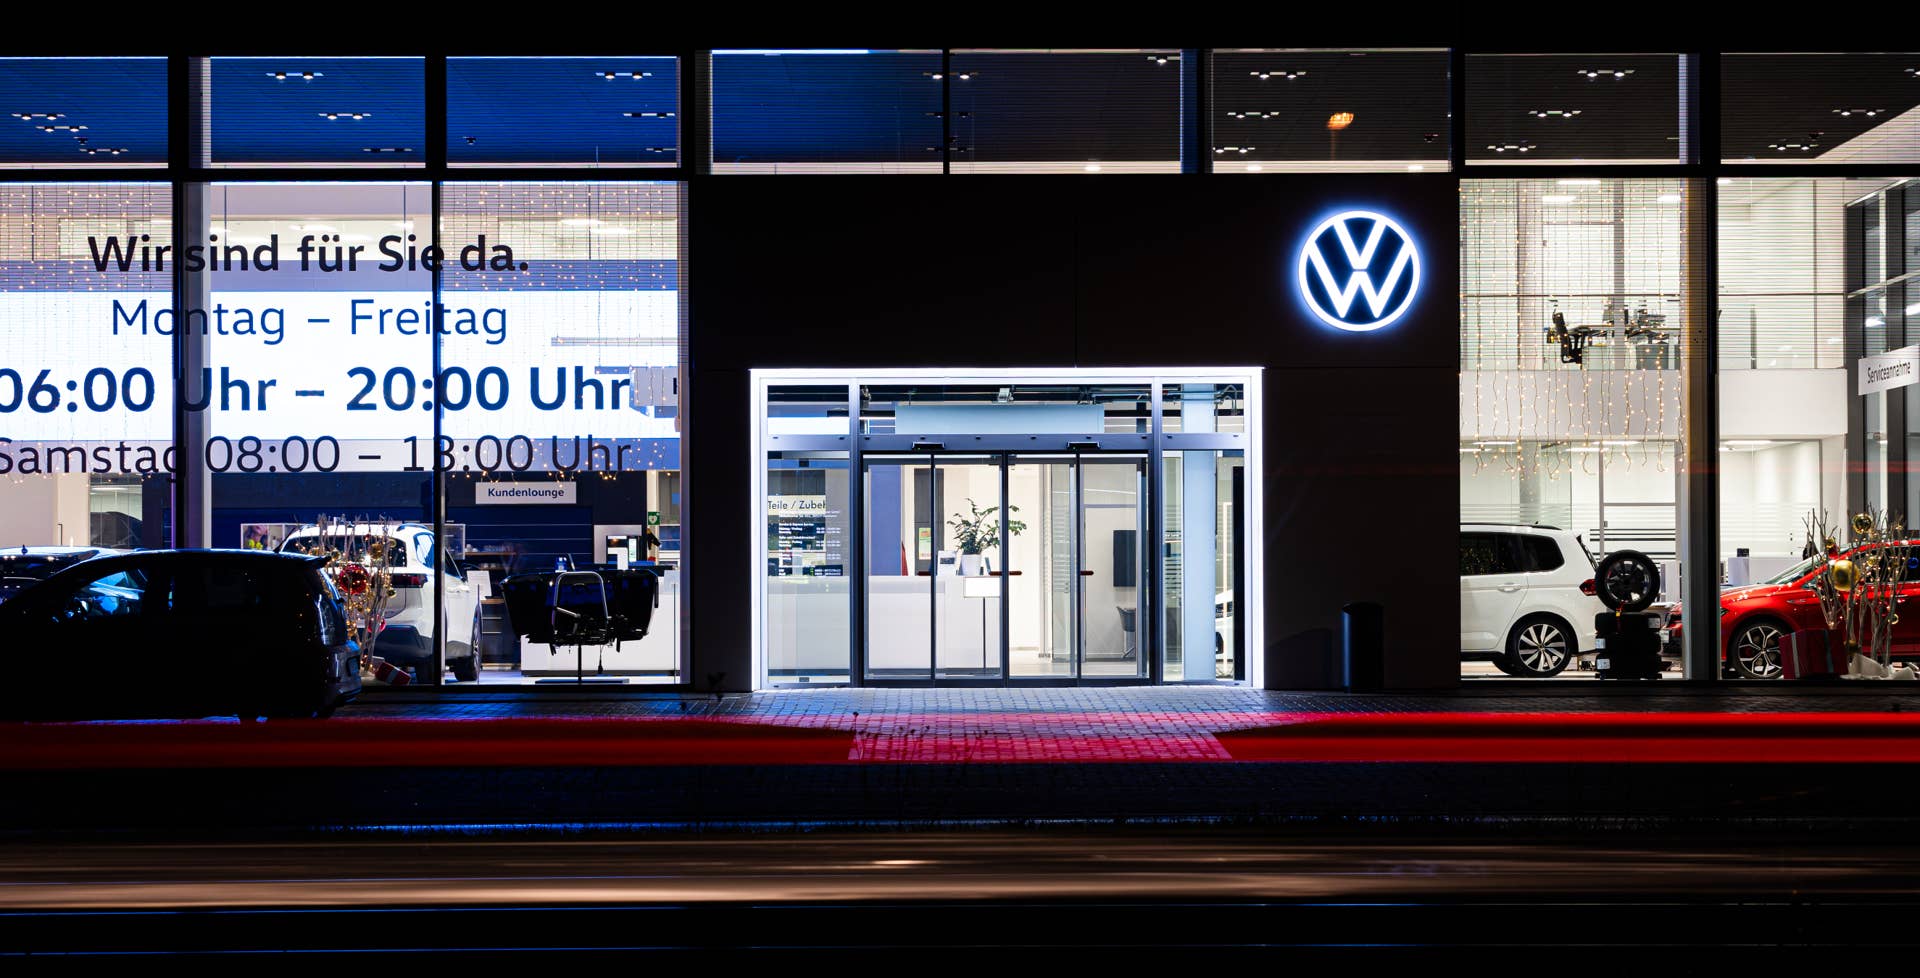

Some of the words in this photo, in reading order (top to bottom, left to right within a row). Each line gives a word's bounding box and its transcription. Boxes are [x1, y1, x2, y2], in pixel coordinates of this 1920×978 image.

[88, 235, 172, 272] Wir
[185, 234, 279, 272] sind
[297, 234, 364, 272] für
[378, 234, 445, 272] Sie
[459, 234, 529, 272] da.
[1302, 213, 1417, 322] VW
[112, 299, 285, 345] Montag
[350, 299, 507, 345] Freitag
[0, 367, 155, 413] 06:00
[181, 366, 277, 412] Uhr
[346, 366, 509, 411] 20:00
[529, 366, 631, 411] Uhr
[205, 435, 340, 473] 08:00
[403, 435, 533, 472] 13:00
[552, 434, 631, 472] Uhr
[488, 487, 565, 499] Kundenlounge
[768, 500, 788, 509] Teile
